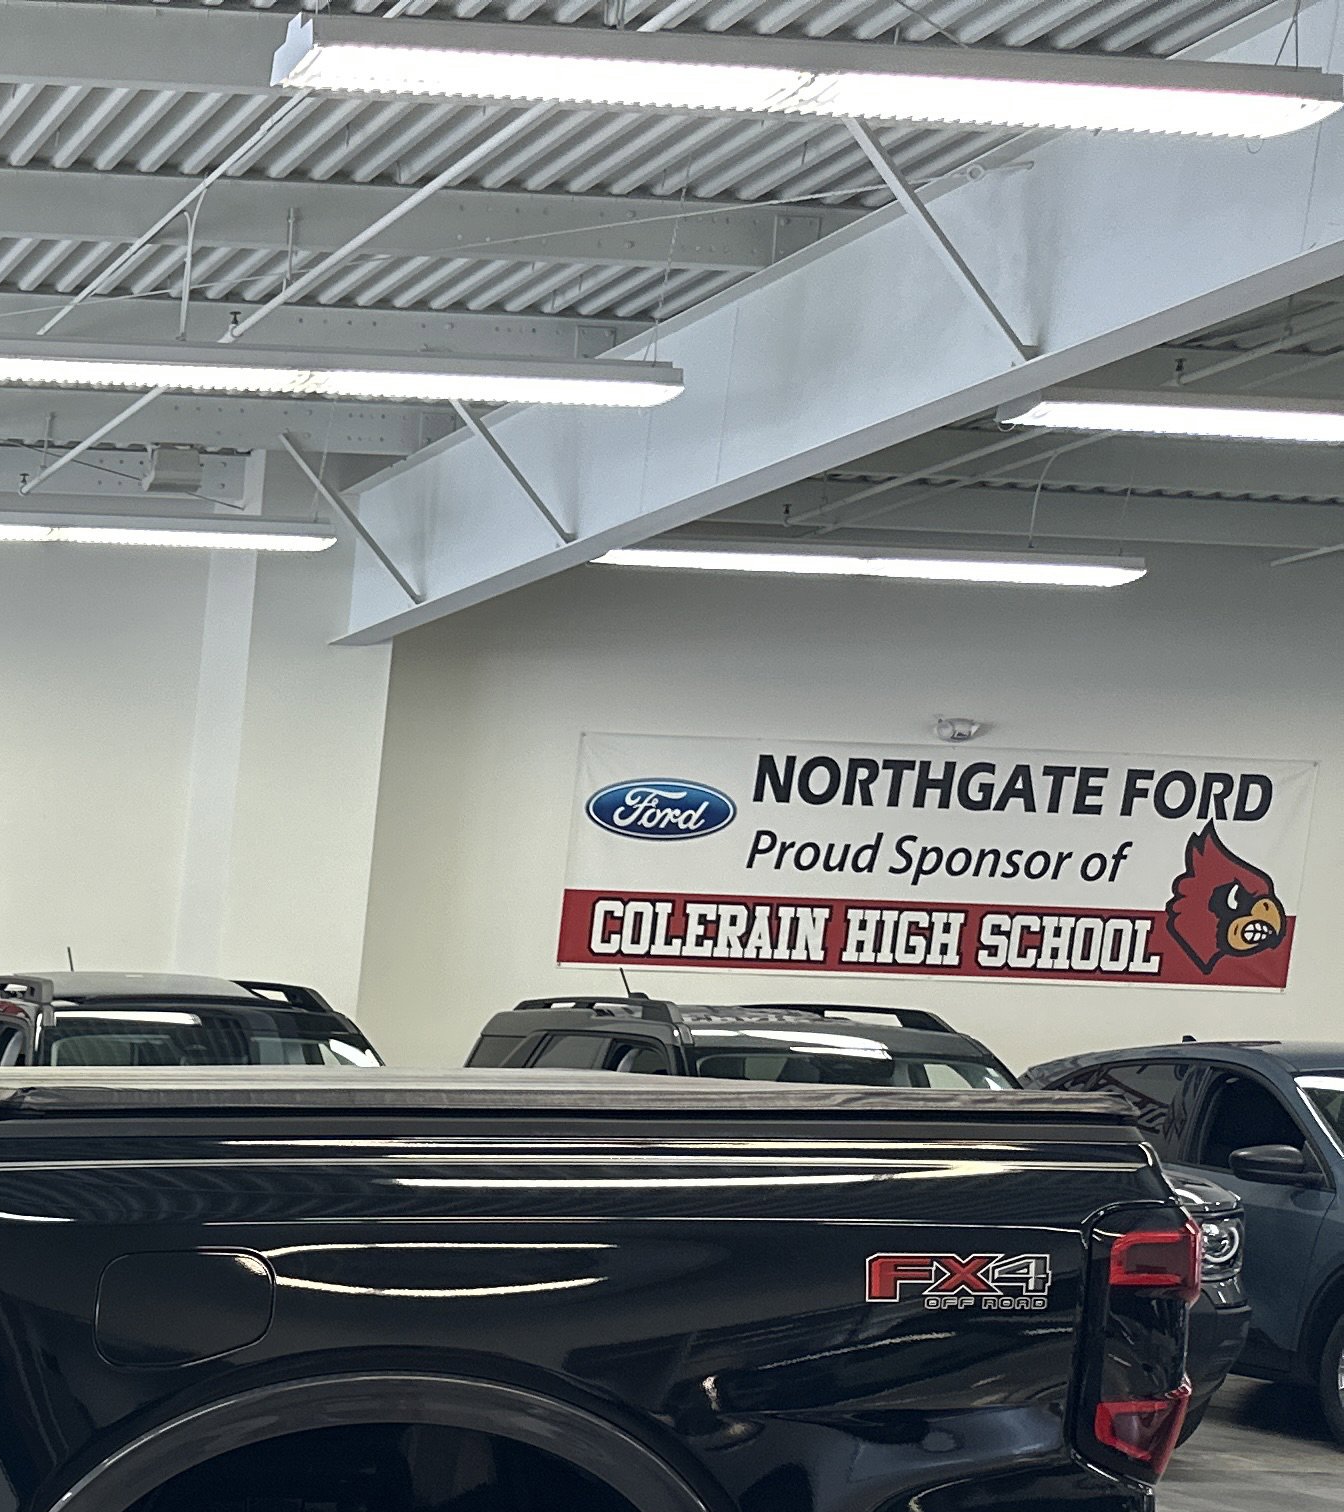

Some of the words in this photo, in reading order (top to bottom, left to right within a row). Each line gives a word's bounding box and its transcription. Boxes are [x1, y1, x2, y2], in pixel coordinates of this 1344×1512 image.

[612, 785, 705, 832] Ford
[752, 754, 1108, 816] NORTHGATE
[1119, 768, 1274, 822] FORD
[746, 830, 880, 876] Proud
[889, 836, 1070, 884] Sponsor
[1080, 842, 1132, 882] of
[589, 900, 826, 962] COLERAIN
[842, 908, 964, 967] HIGH
[978, 916, 1160, 974] SCHOOL
[866, 1252, 1051, 1303] FX4
[924, 1296, 975, 1310] OFF
[981, 1296, 1048, 1310] ROAD
